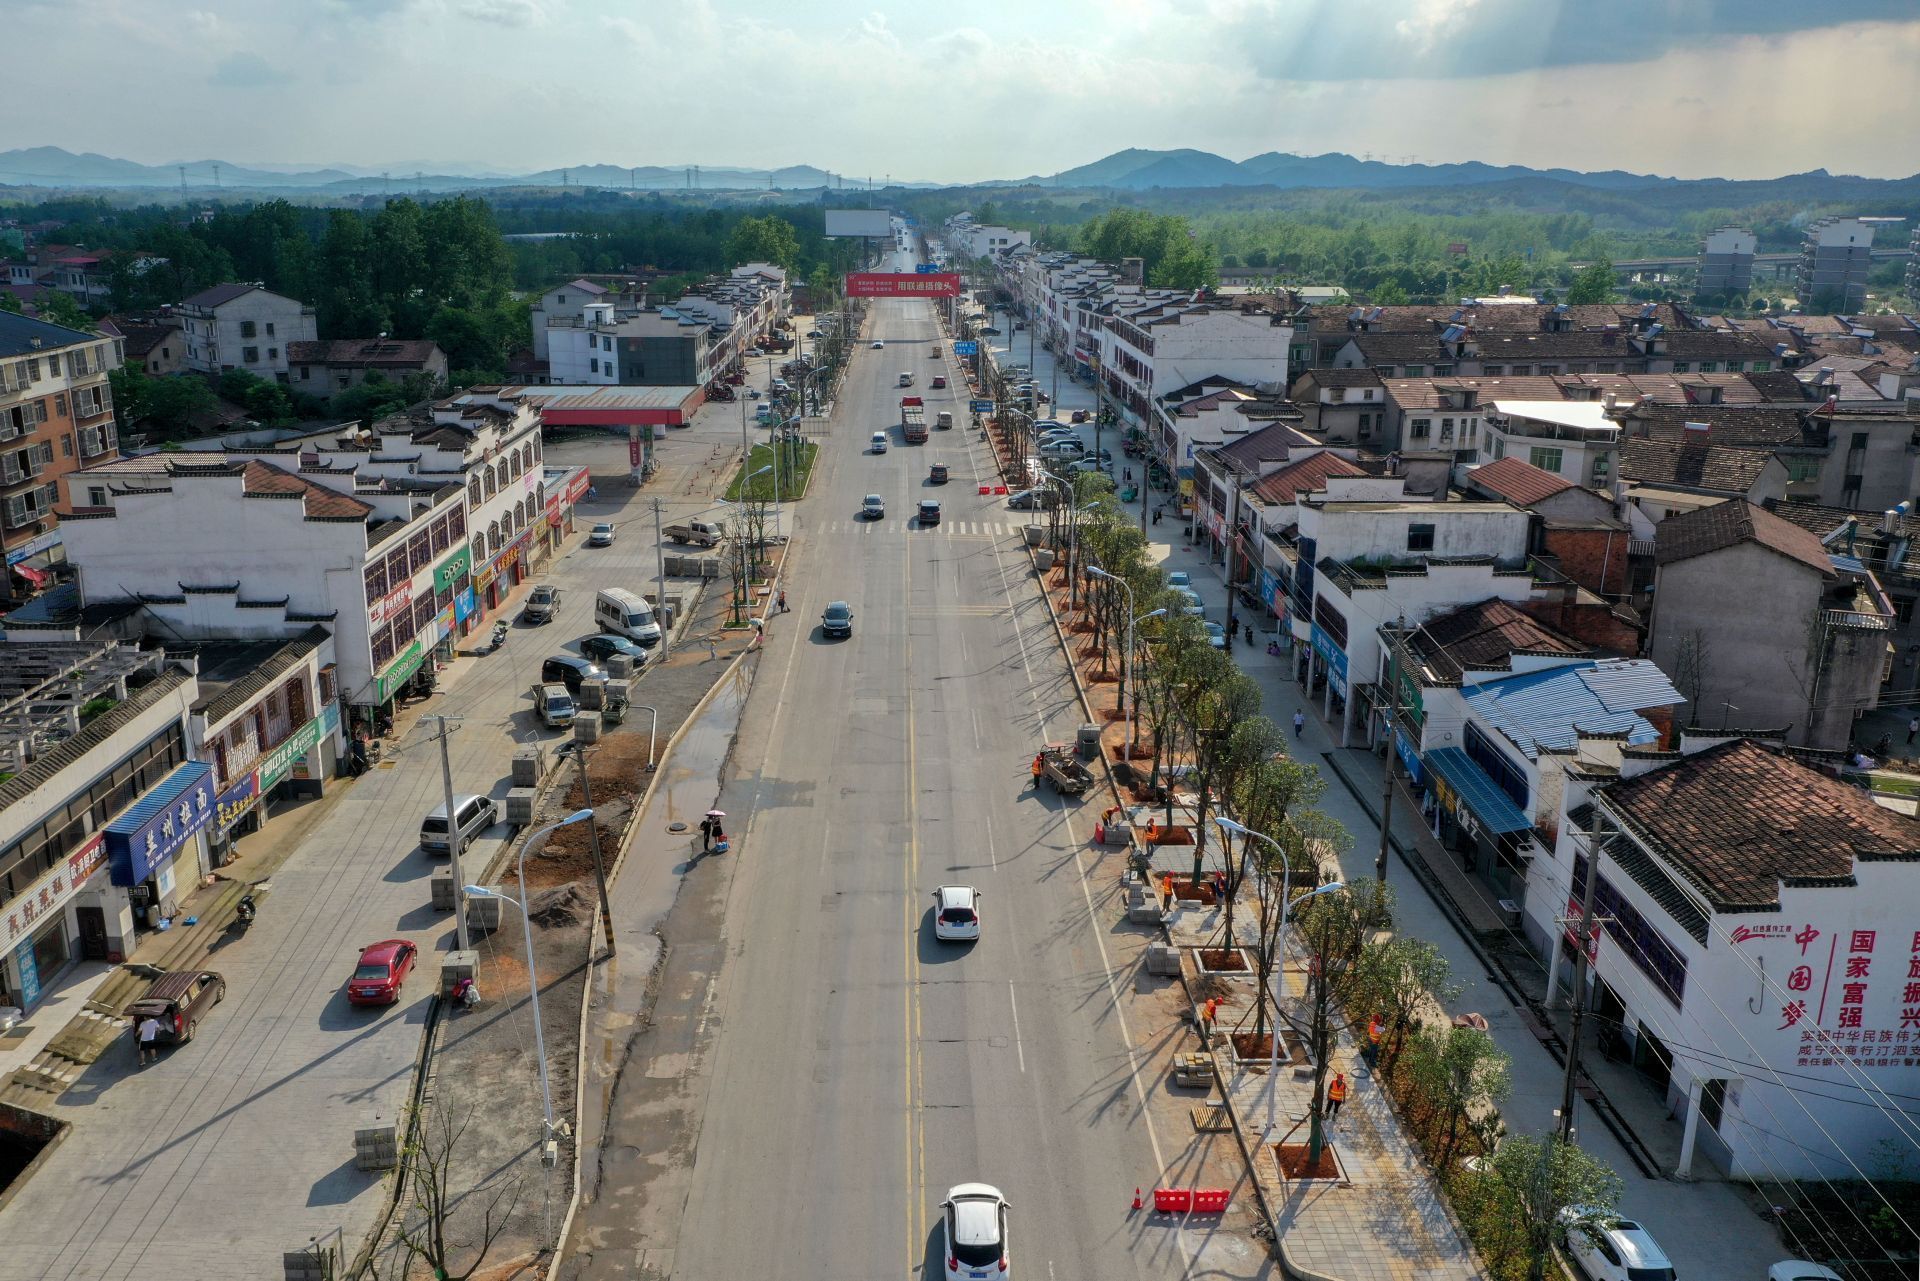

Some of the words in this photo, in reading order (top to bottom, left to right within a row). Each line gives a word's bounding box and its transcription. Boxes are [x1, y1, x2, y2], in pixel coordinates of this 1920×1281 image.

[146, 787, 207, 857] 兰州拉面
[1776, 923, 1820, 1031] 中国梦
[1838, 930, 1877, 1029] 国家富强
